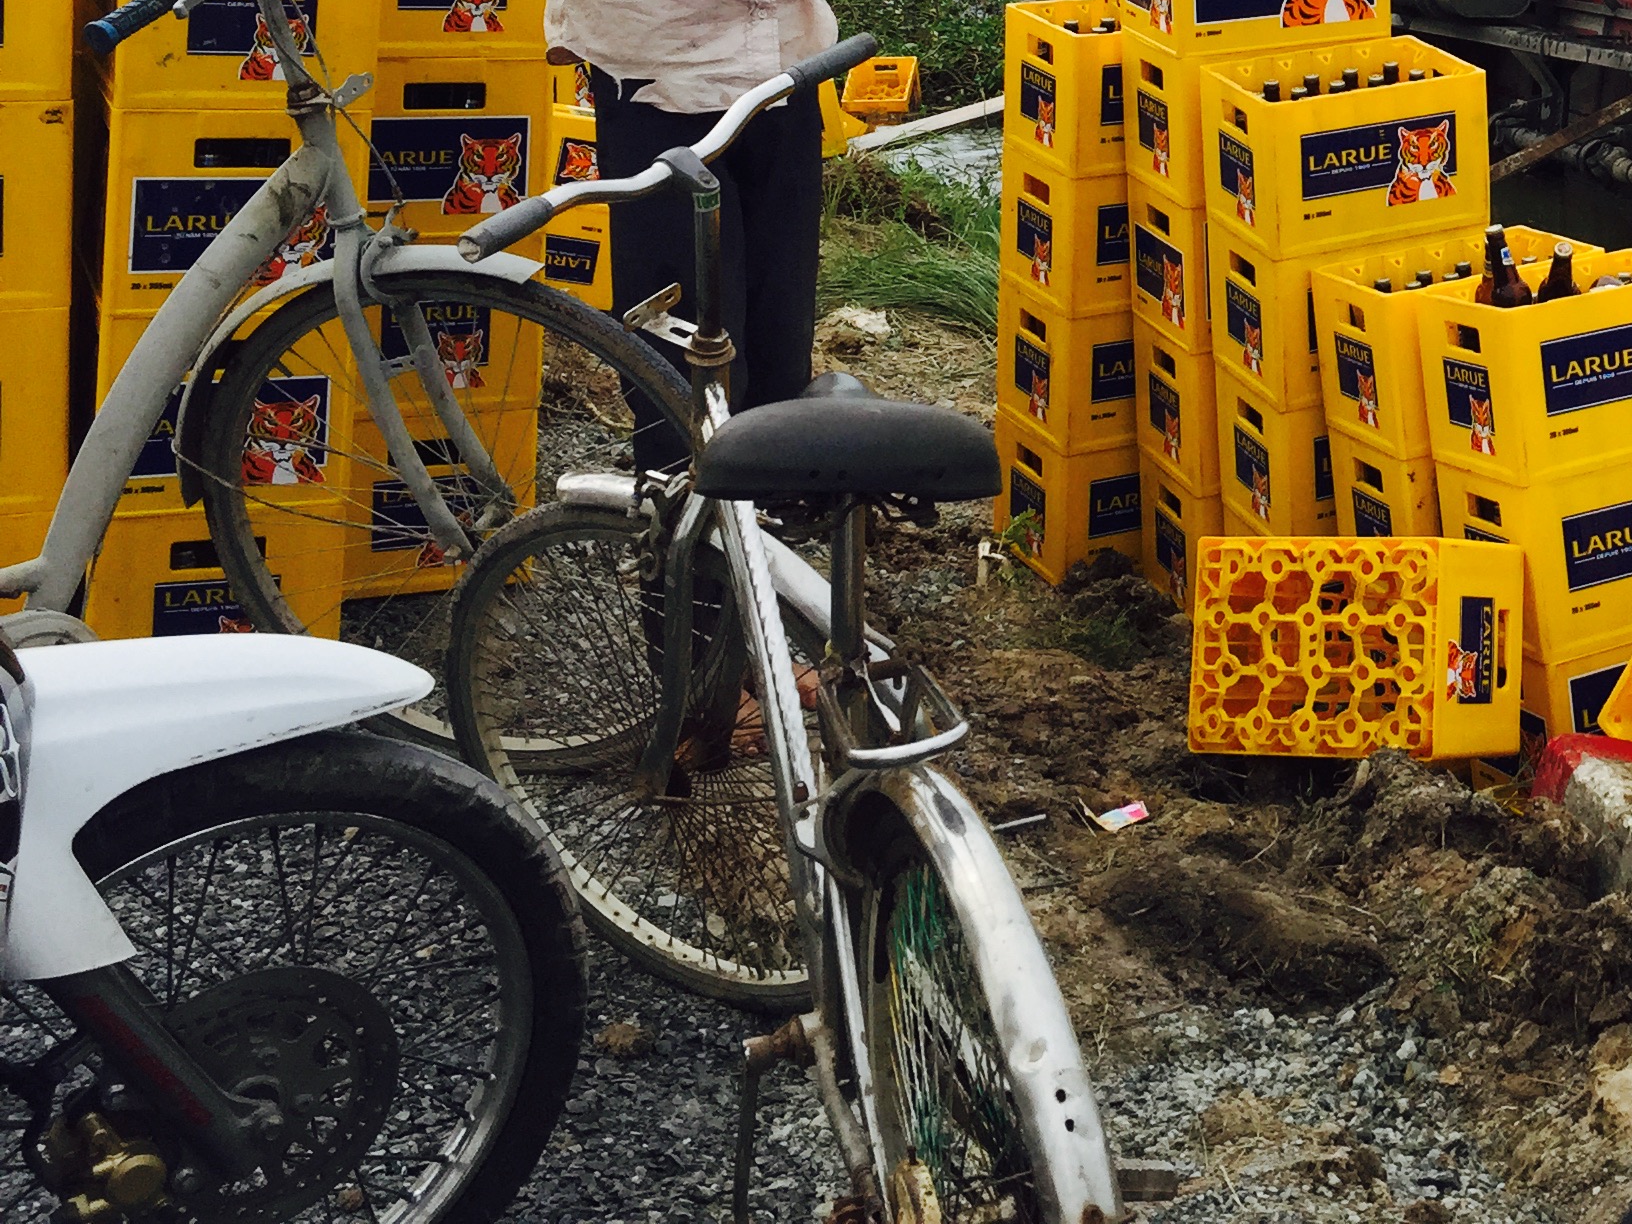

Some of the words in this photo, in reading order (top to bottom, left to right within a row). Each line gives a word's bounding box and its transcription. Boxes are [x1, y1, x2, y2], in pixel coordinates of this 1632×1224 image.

[1023, 67, 1053, 92] LARUE
[1139, 94, 1166, 120] LARUE
[1221, 136, 1251, 166] LARUE
[1308, 143, 1392, 171] LARUE
[1020, 205, 1049, 232] LARUE
[1138, 248, 1163, 275] LARUE
[1228, 286, 1259, 316] LARUE
[1018, 341, 1046, 370] LARUE
[1337, 339, 1371, 364] LARUE
[1446, 364, 1486, 388] LARUE
[1151, 378, 1178, 408] LARUE
[1236, 430, 1267, 465] LARUE
[1013, 472, 1041, 503] LARUE
[1355, 494, 1388, 524] LARUE
[1482, 605, 1492, 694] LARUE
